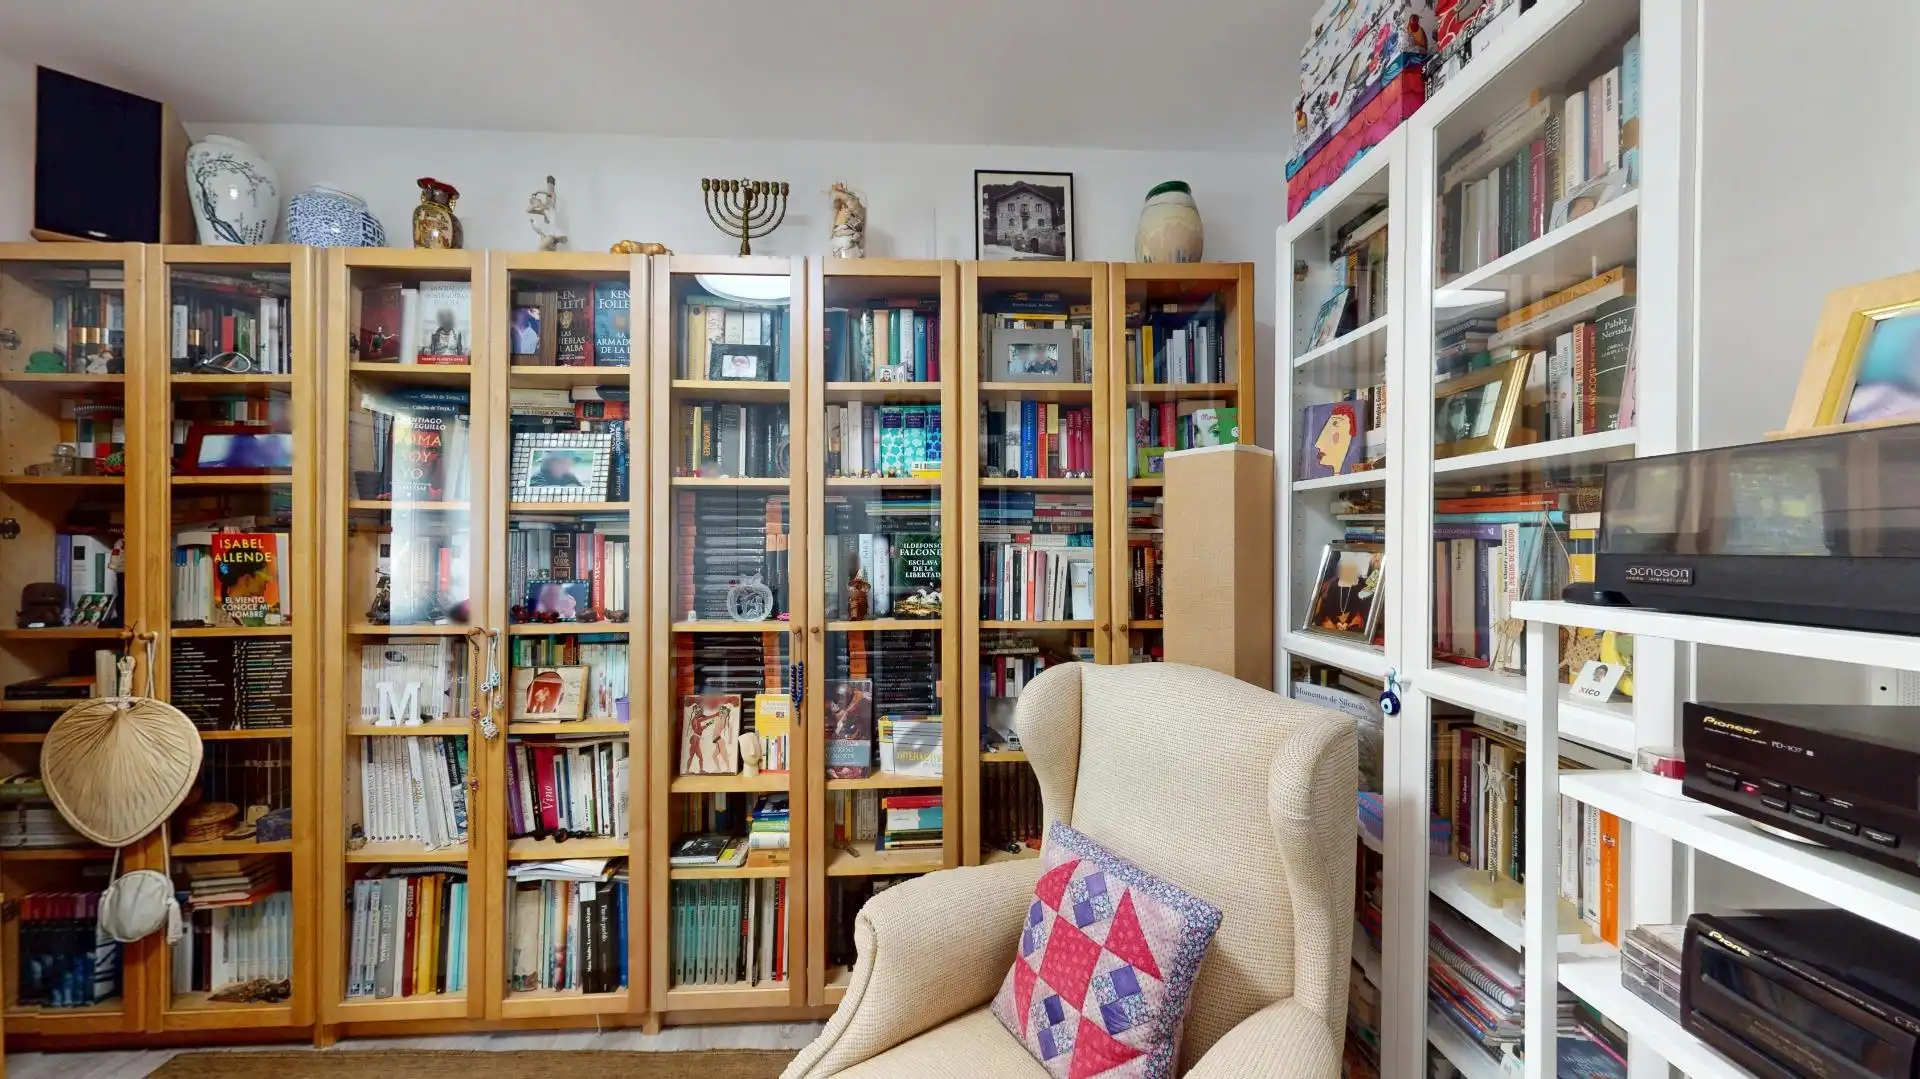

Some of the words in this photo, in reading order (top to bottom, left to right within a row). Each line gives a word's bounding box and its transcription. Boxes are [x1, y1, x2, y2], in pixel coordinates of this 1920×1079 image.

[599, 299, 630, 309] FOLLE
[1604, 317, 1628, 330] Pablo
[1601, 325, 1632, 340] Neruda
[220, 539, 264, 549] ISABEL
[215, 551, 272, 562] ALLENDE
[899, 548, 942, 556] FALCONE
[236, 596, 265, 604] VIENTO
[222, 603, 258, 611] CONOCE
[1295, 686, 1328, 701] Momentos
[1329, 695, 1338, 704] de
[375, 682, 424, 727] M
[1703, 716, 1760, 735] Pioneer
[542, 785, 555, 810] Vino
[1709, 930, 1750, 957] Pione
